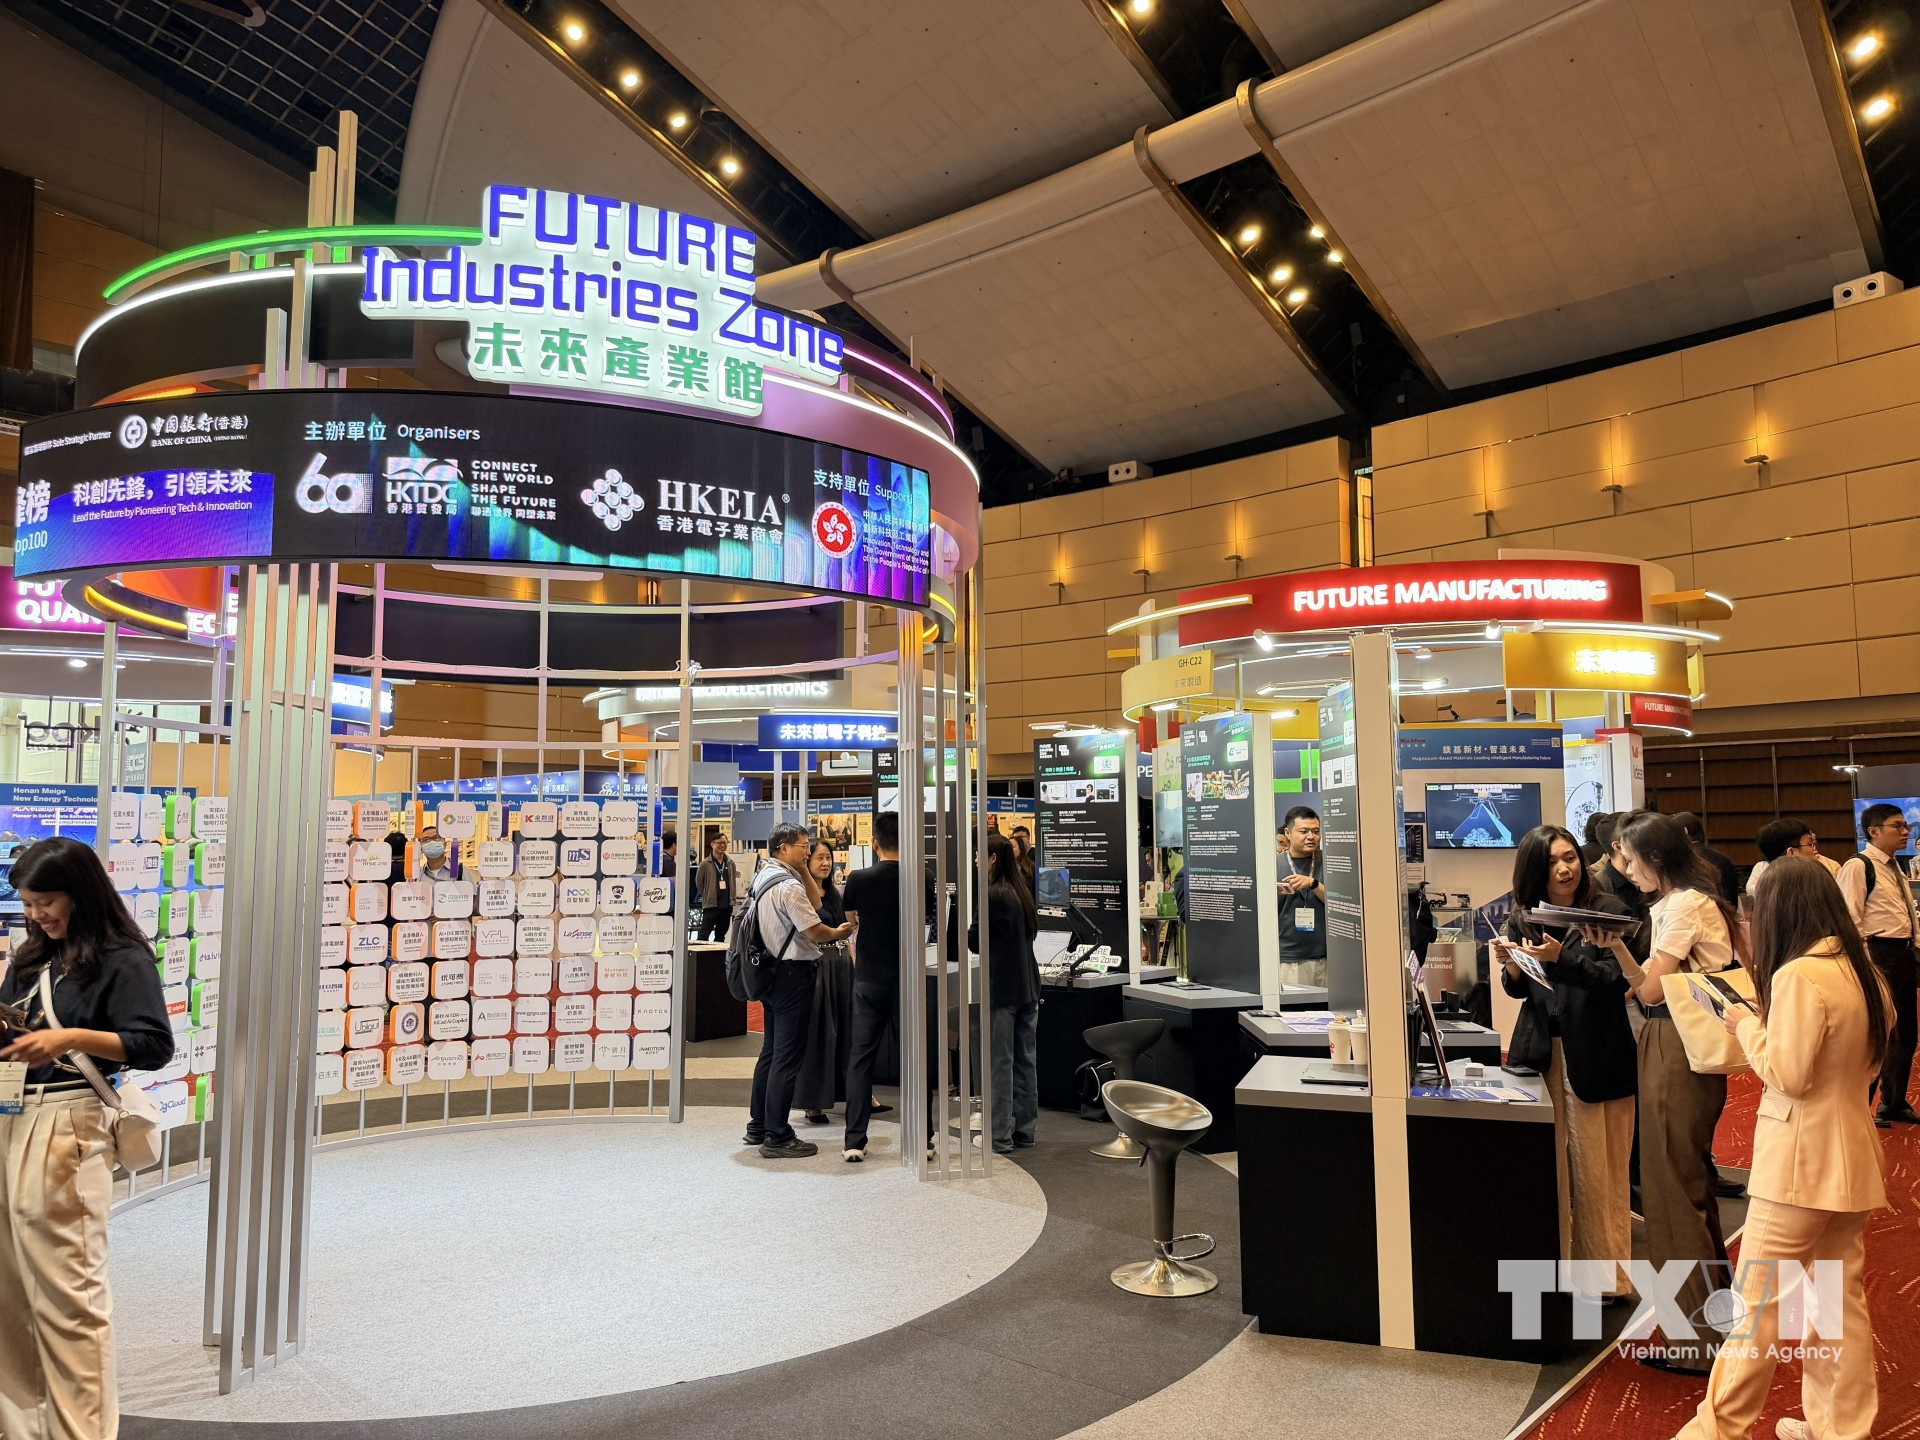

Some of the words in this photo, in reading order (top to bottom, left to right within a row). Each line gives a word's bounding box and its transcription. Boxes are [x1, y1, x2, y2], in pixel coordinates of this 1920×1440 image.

[488, 184, 757, 284] FUTURE
[361, 245, 700, 333] Industries
[719, 287, 845, 374] Zone
[473, 322, 764, 405] 未來產業館
[88, 431, 112, 441] Partner
[303, 421, 387, 442] 主辦單位
[397, 424, 481, 442] Organisers
[151, 439, 173, 447] BANK
[174, 437, 184, 445] OF
[185, 435, 212, 444] CHINA
[471, 460, 538, 472] CONNECT
[471, 470, 498, 481] THE
[503, 472, 554, 485] WORLD
[813, 468, 870, 497] 支持單位
[386, 481, 458, 503] HKTDC
[471, 483, 517, 494] SHAPE
[471, 494, 498, 504] THE
[503, 495, 557, 508] FUTURE
[73, 512, 89, 523] Lead
[90, 511, 100, 520] the
[101, 509, 124, 519] Future
[125, 507, 134, 519] by
[135, 504, 176, 516] Pioneering
[178, 502, 197, 513] Tech
[198, 503, 205, 512] &
[206, 499, 253, 511] Innovation
[656, 514, 784, 545] 香港電子業商會
[874, 546, 906, 561] Government
[891, 541, 920, 556] Technology
[1292, 583, 1389, 612] FUTURE
[1394, 578, 1608, 604] MANUFACTURING
[1178, 656, 1203, 668] GH-C22
[1644, 702, 1664, 712] FUTURE
[41, 787, 66, 795] Meige
[33, 795, 62, 803] Energy
[1430, 962, 1453, 970] Limited
